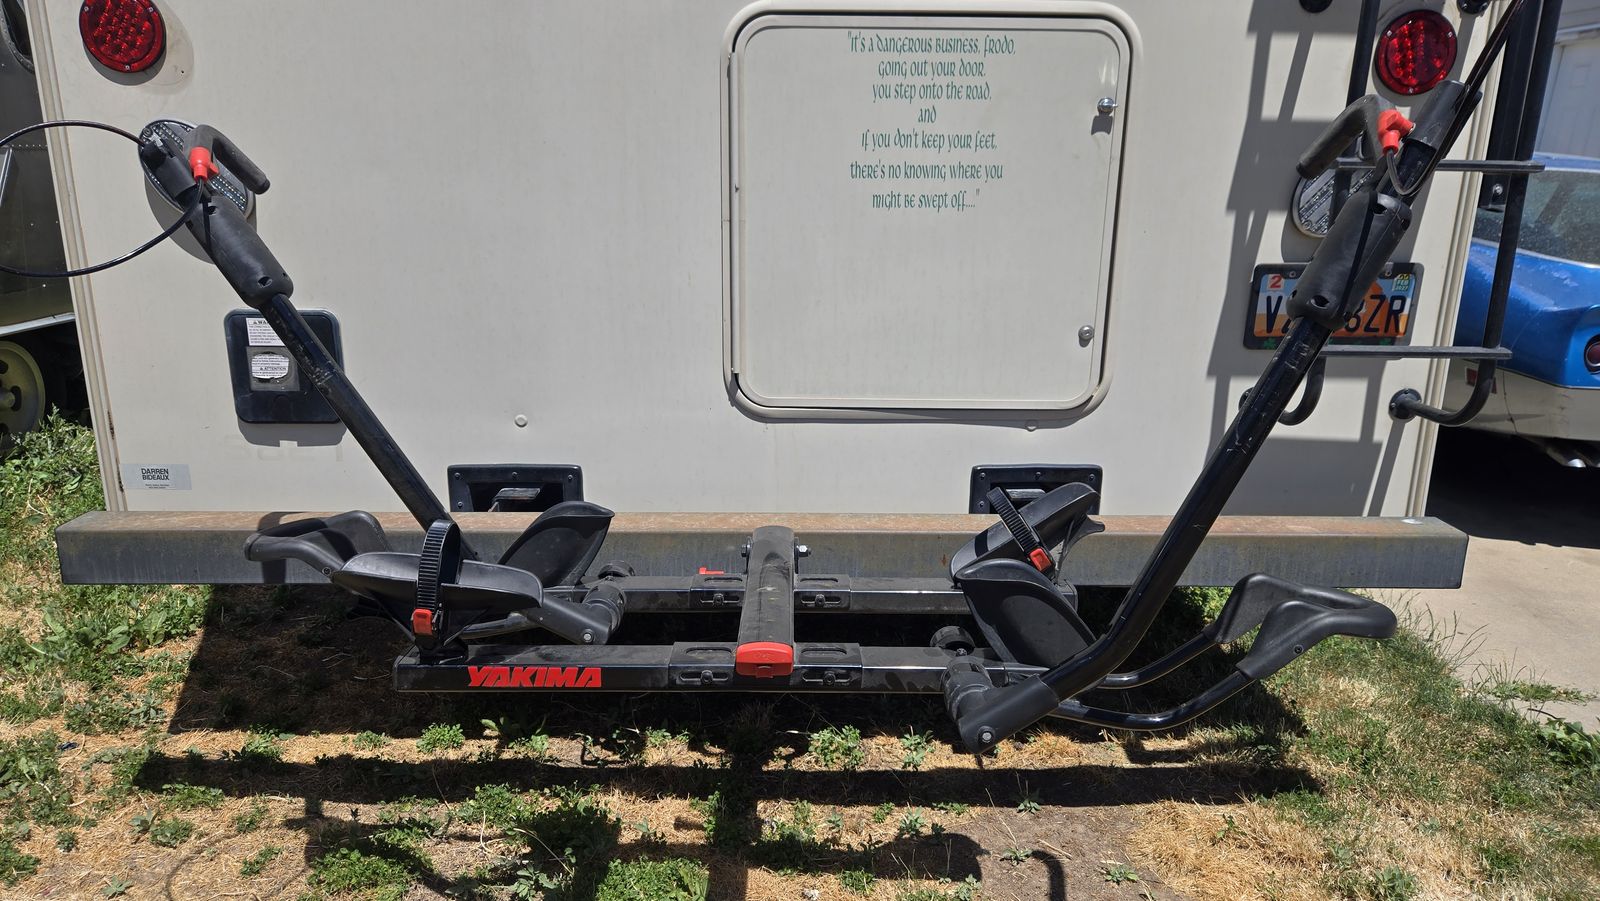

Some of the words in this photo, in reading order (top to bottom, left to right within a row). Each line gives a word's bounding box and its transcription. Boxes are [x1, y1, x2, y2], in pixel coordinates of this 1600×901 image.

[868, 37, 874, 53] a
[876, 33, 932, 56] dangerous
[878, 60, 907, 79] going
[910, 60, 928, 77] out
[930, 61, 956, 80] your
[872, 83, 891, 103] you
[894, 82, 916, 104] step
[919, 82, 943, 100] onto
[946, 80, 963, 100] the
[918, 105, 937, 123] and
[872, 132, 890, 152] you
[894, 128, 919, 149] don't
[921, 130, 944, 153] keep
[948, 133, 973, 153] your
[850, 159, 885, 179] there's
[888, 164, 901, 179] no
[904, 160, 946, 182] knowing
[949, 160, 982, 179] where
[984, 164, 1003, 183] you
[872, 190, 901, 210] might
[904, 194, 915, 208] be
[918, 191, 948, 212] swept
[1269, 275, 1283, 289] 2
[467, 666, 602, 688] YAKIMA
